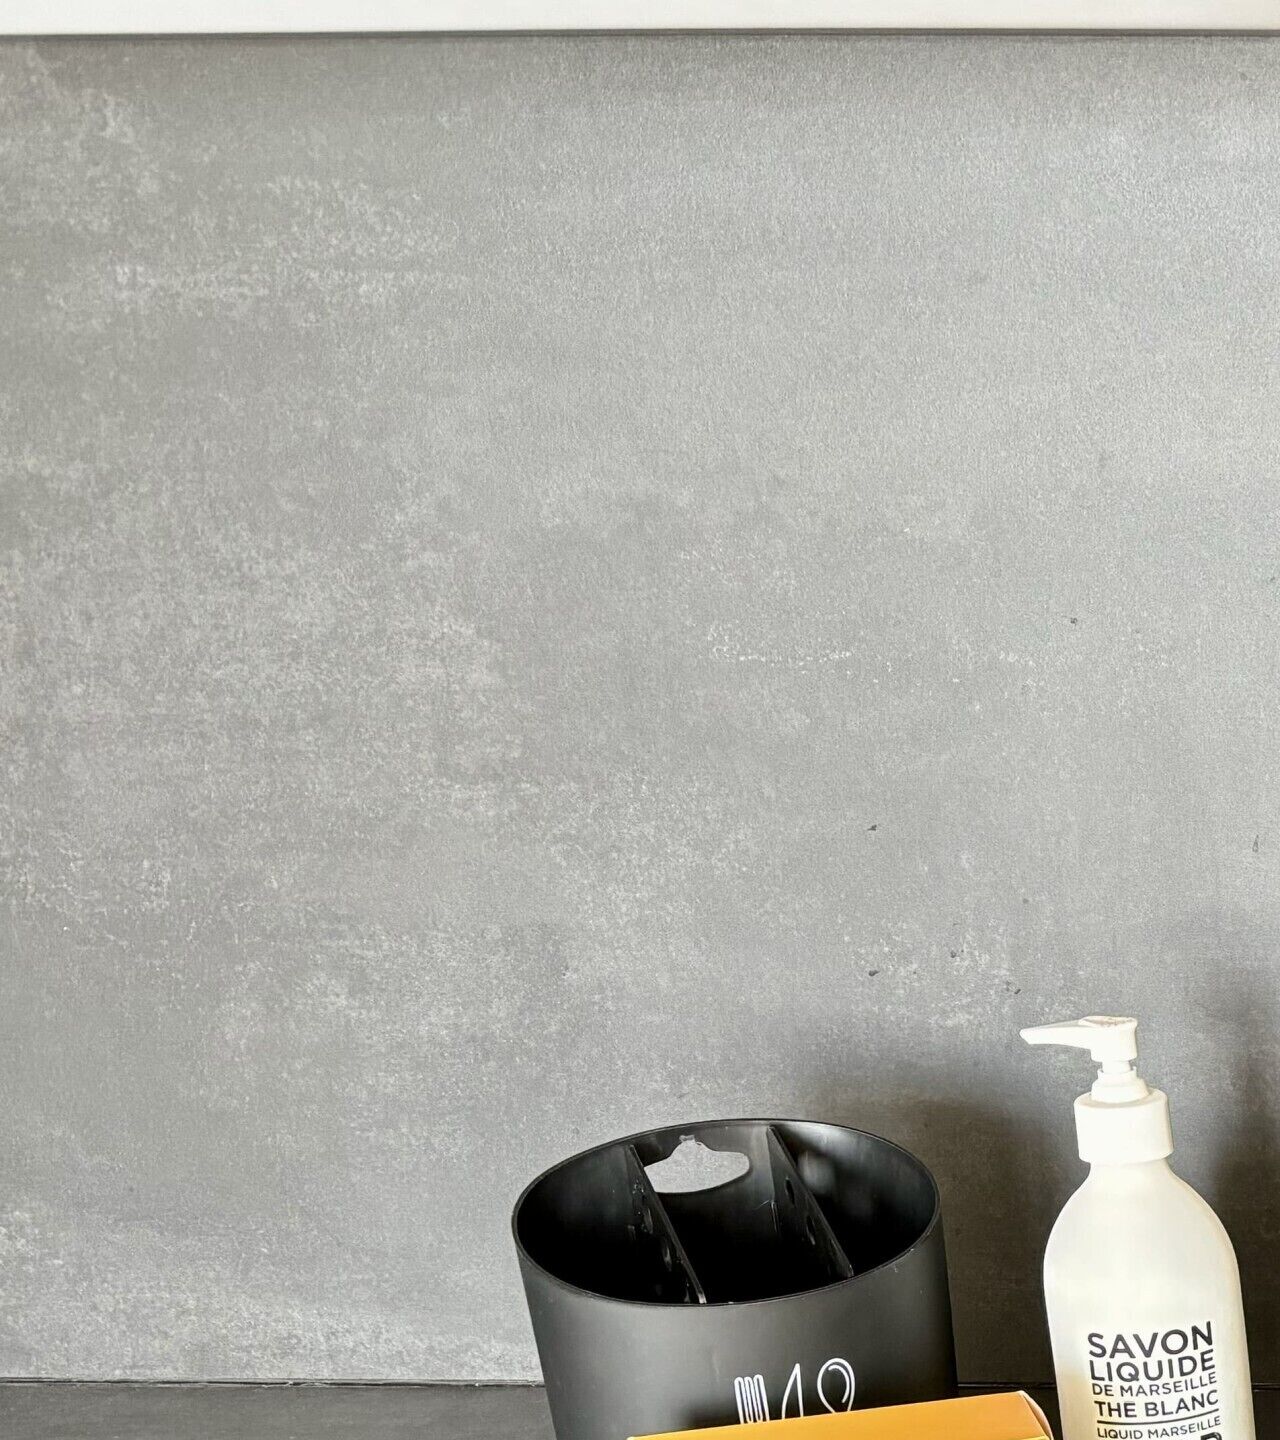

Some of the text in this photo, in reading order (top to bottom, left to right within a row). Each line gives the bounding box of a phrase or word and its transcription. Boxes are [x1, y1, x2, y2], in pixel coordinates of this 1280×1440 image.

[1087, 1321, 1213, 1359] SAVON
[1090, 1348, 1216, 1382] LIQUIDE
[1092, 1371, 1217, 1397] DE MARSEILLE
[1145, 1389, 1219, 1417] BLANC
[1097, 1416, 1221, 1440] LIQUID MARSEILLE
